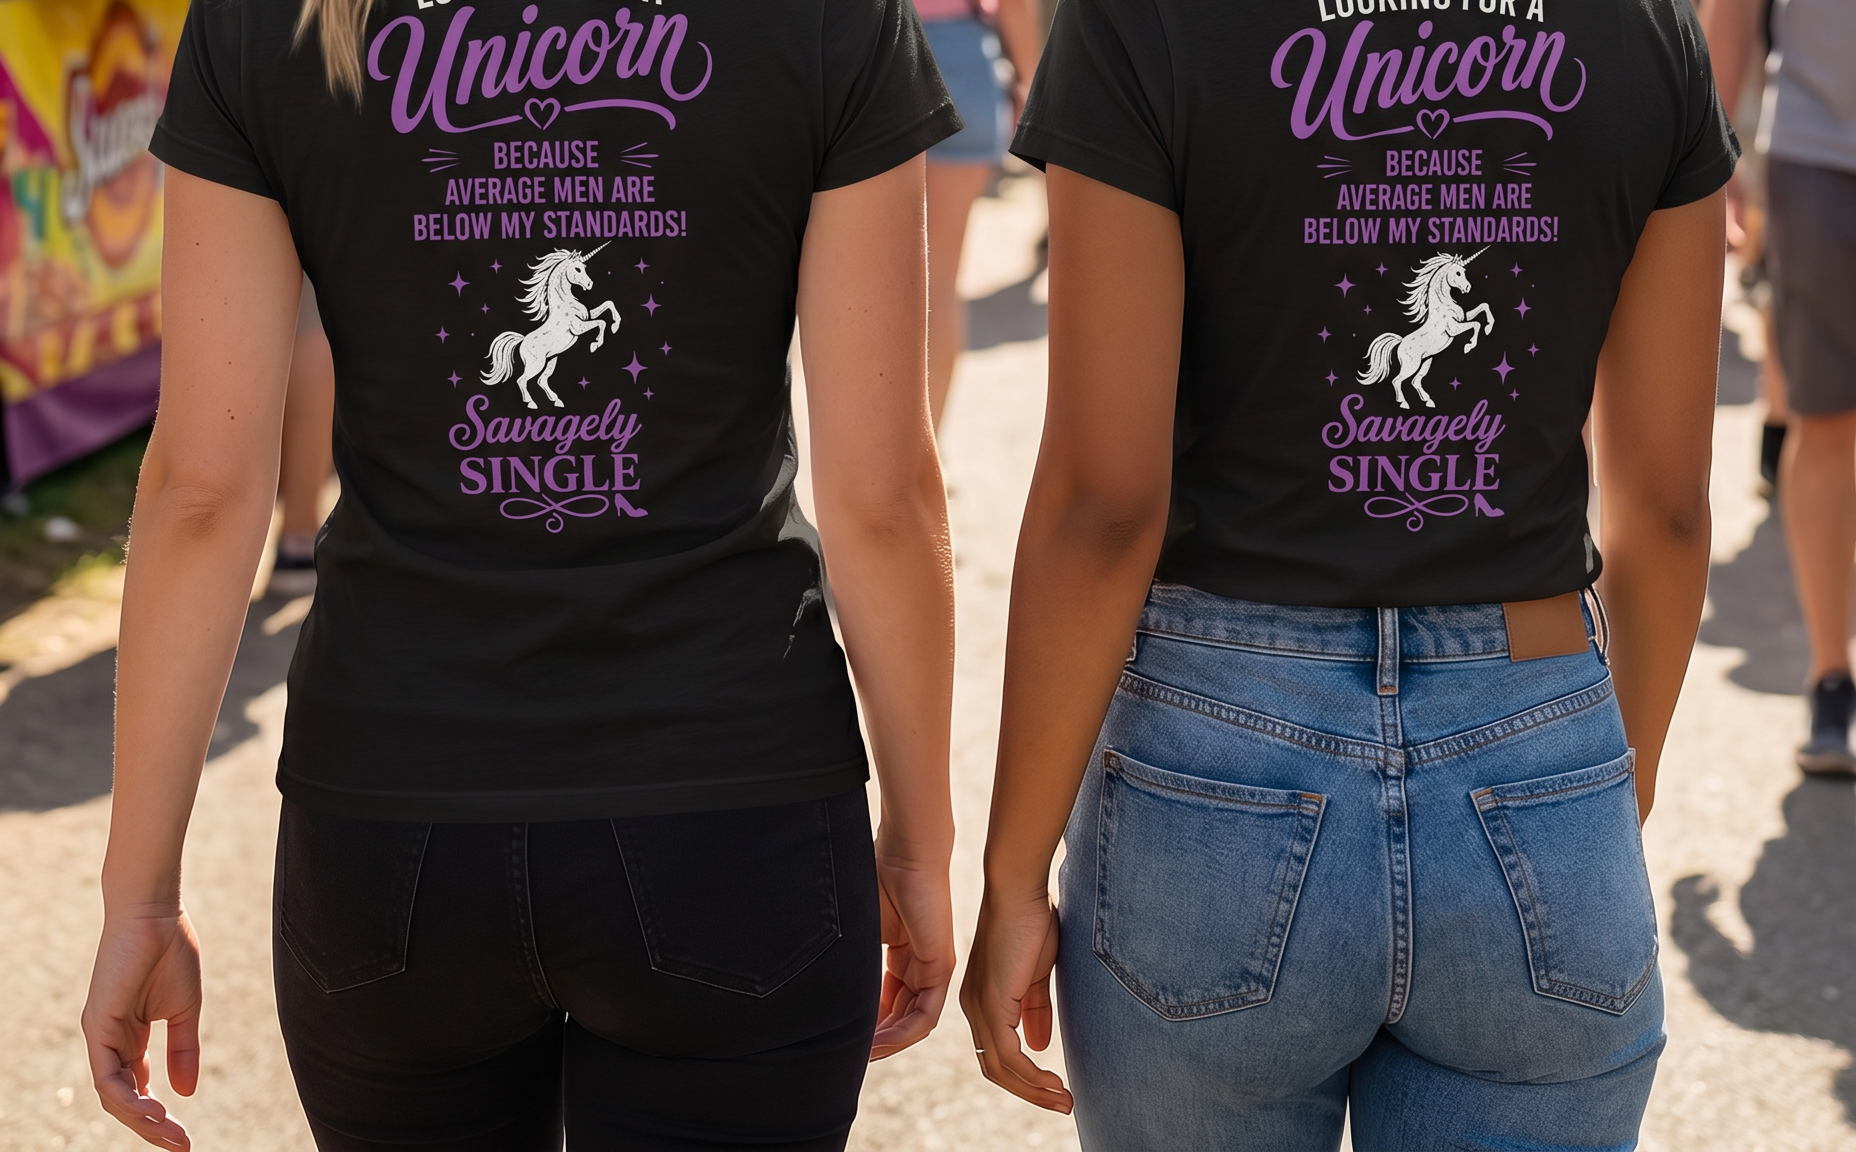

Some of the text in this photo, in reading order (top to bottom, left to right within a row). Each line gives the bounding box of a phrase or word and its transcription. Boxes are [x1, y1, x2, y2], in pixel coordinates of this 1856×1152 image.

[366, 3, 713, 135] Unicorn
[1269, 19, 1587, 142] Unicorn
[493, 139, 600, 170] BECAUSE
[1386, 148, 1483, 177] BECAUSE
[445, 175, 656, 206] AVERAGE MEN ARE
[1336, 182, 1533, 211] AVERAGE MEN ARE
[413, 209, 687, 241] BELOW MY STANDARDS!
[1303, 215, 1559, 245] BELOW MY STANDARDS!
[447, 393, 643, 455] Savagely
[1320, 392, 1507, 455] Savagely
[459, 452, 642, 495] SINGLE
[1327, 452, 1501, 494] SINGLE
